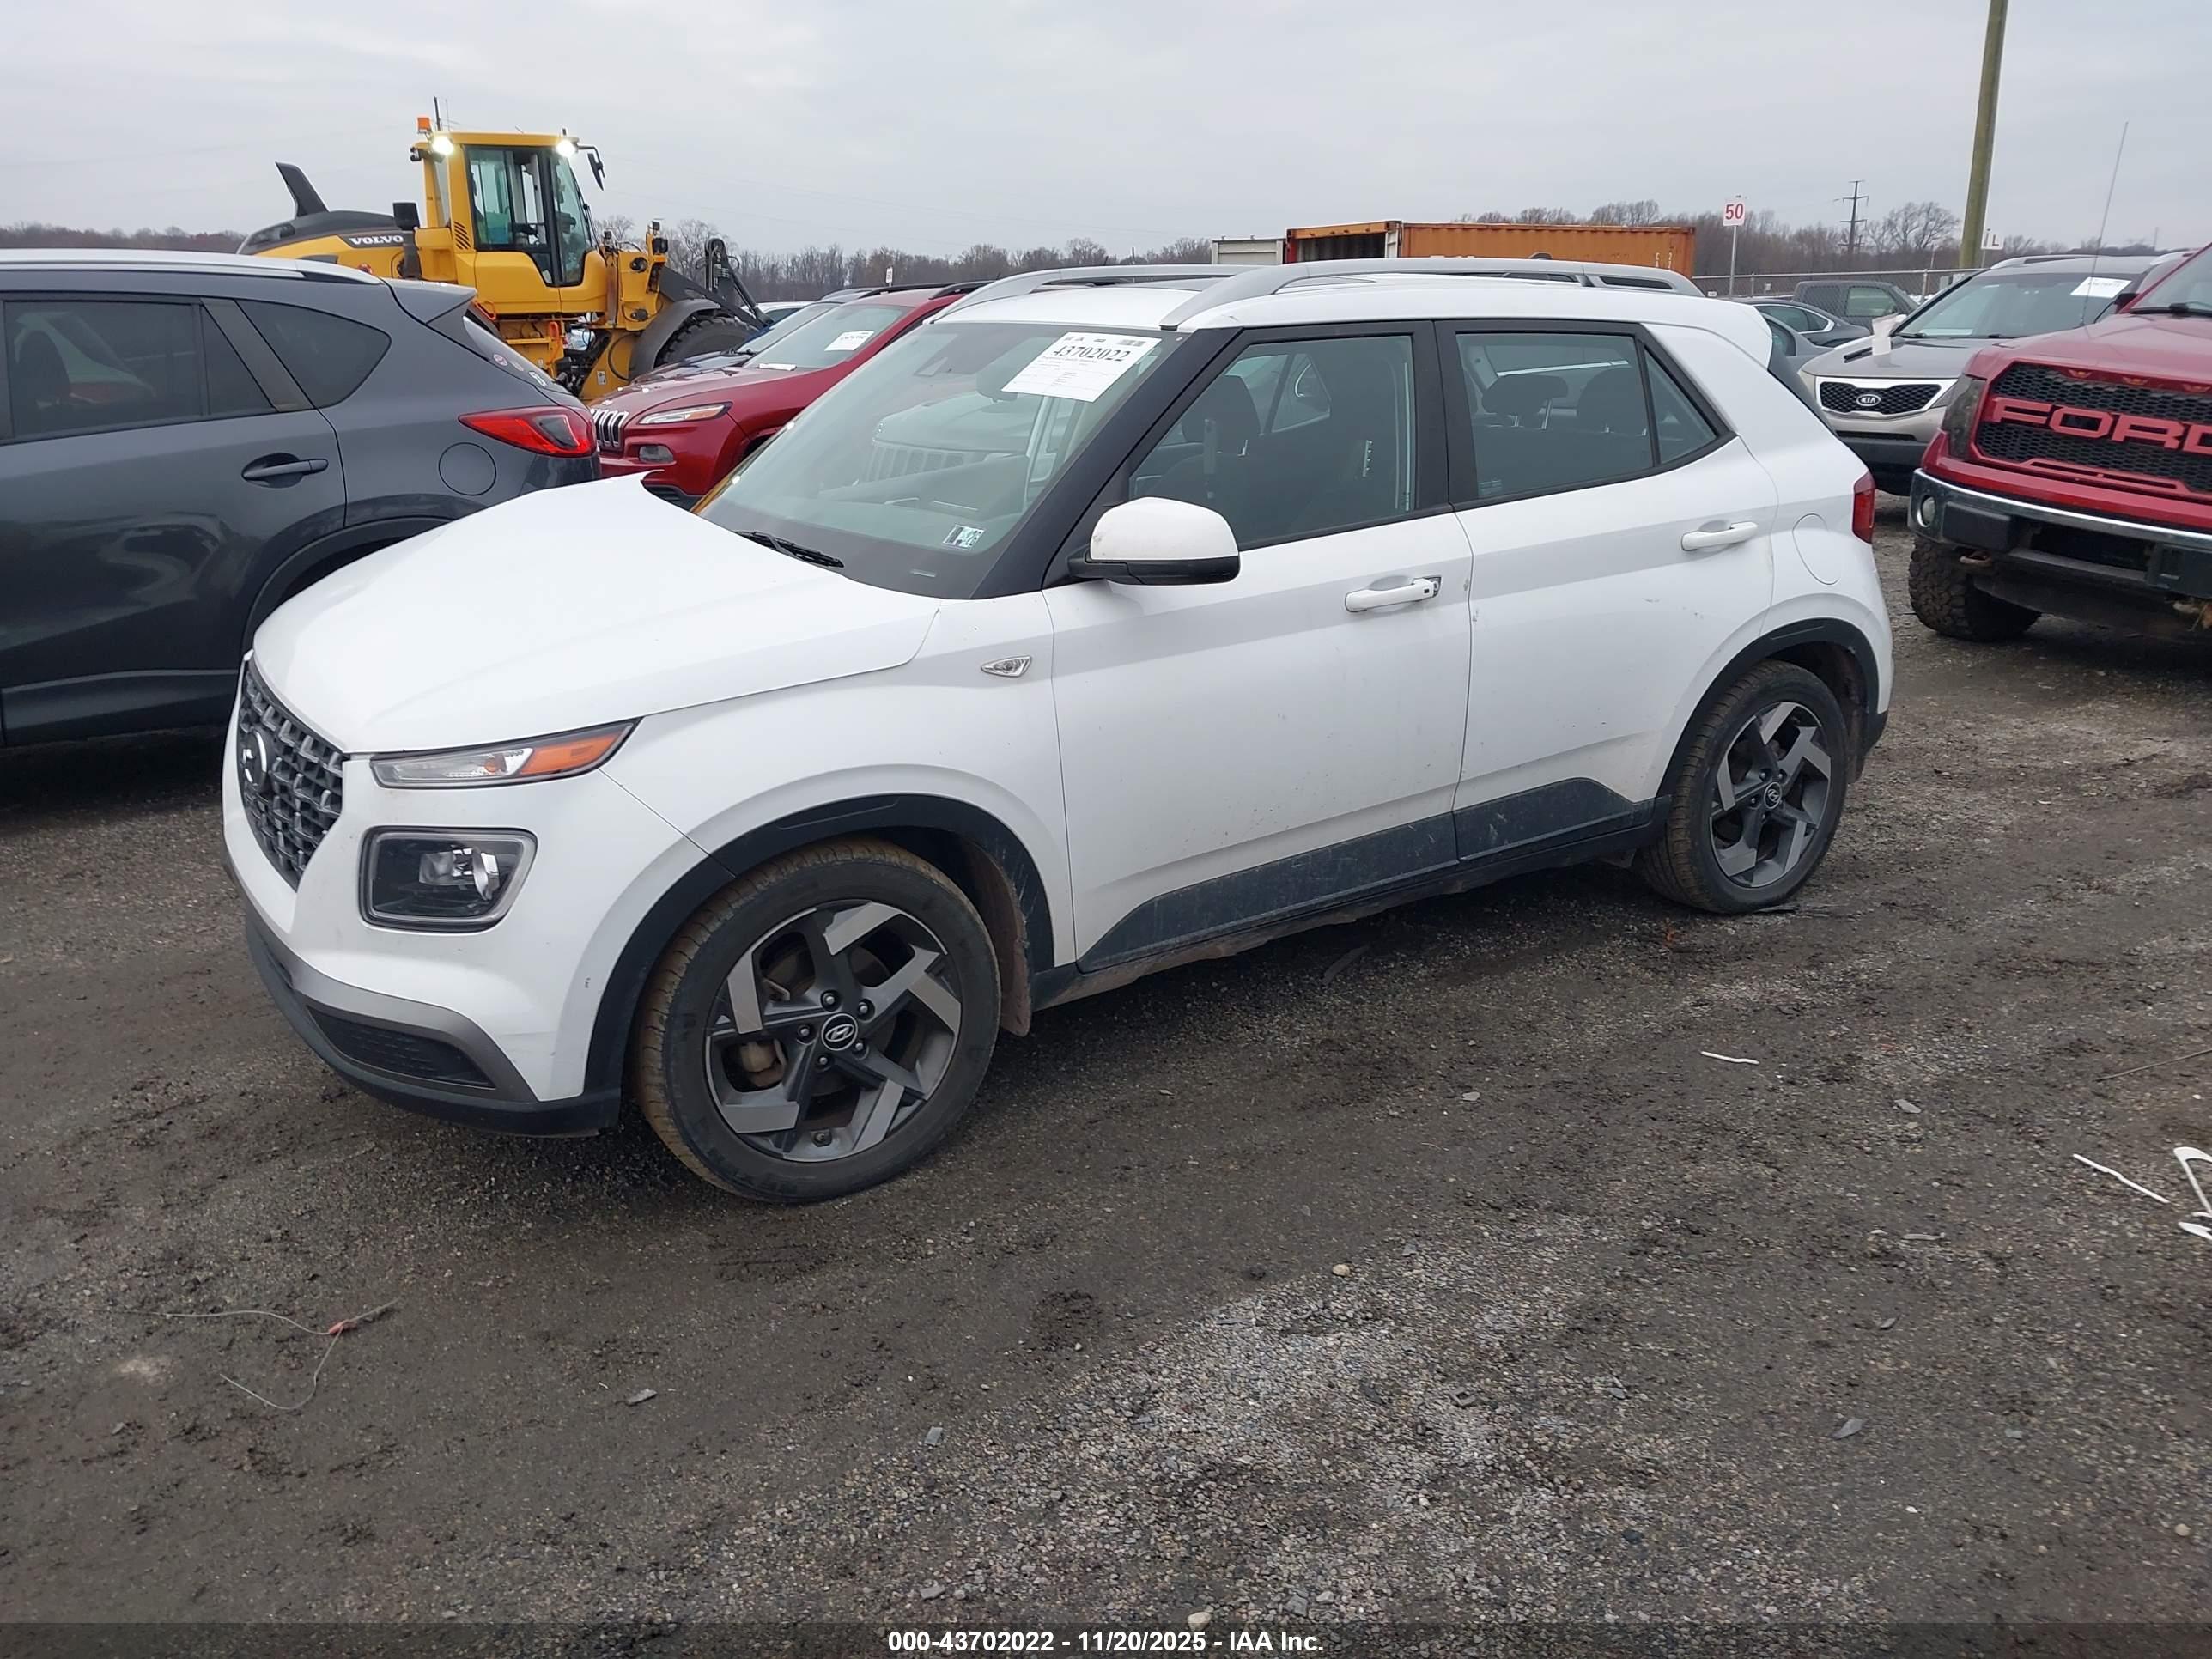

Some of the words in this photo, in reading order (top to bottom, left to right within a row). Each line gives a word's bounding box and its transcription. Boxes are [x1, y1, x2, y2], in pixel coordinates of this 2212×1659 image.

[1725, 203, 1744, 220] 50
[349, 234, 404, 246] VOLVO
[1053, 345, 1132, 362] 43702022
